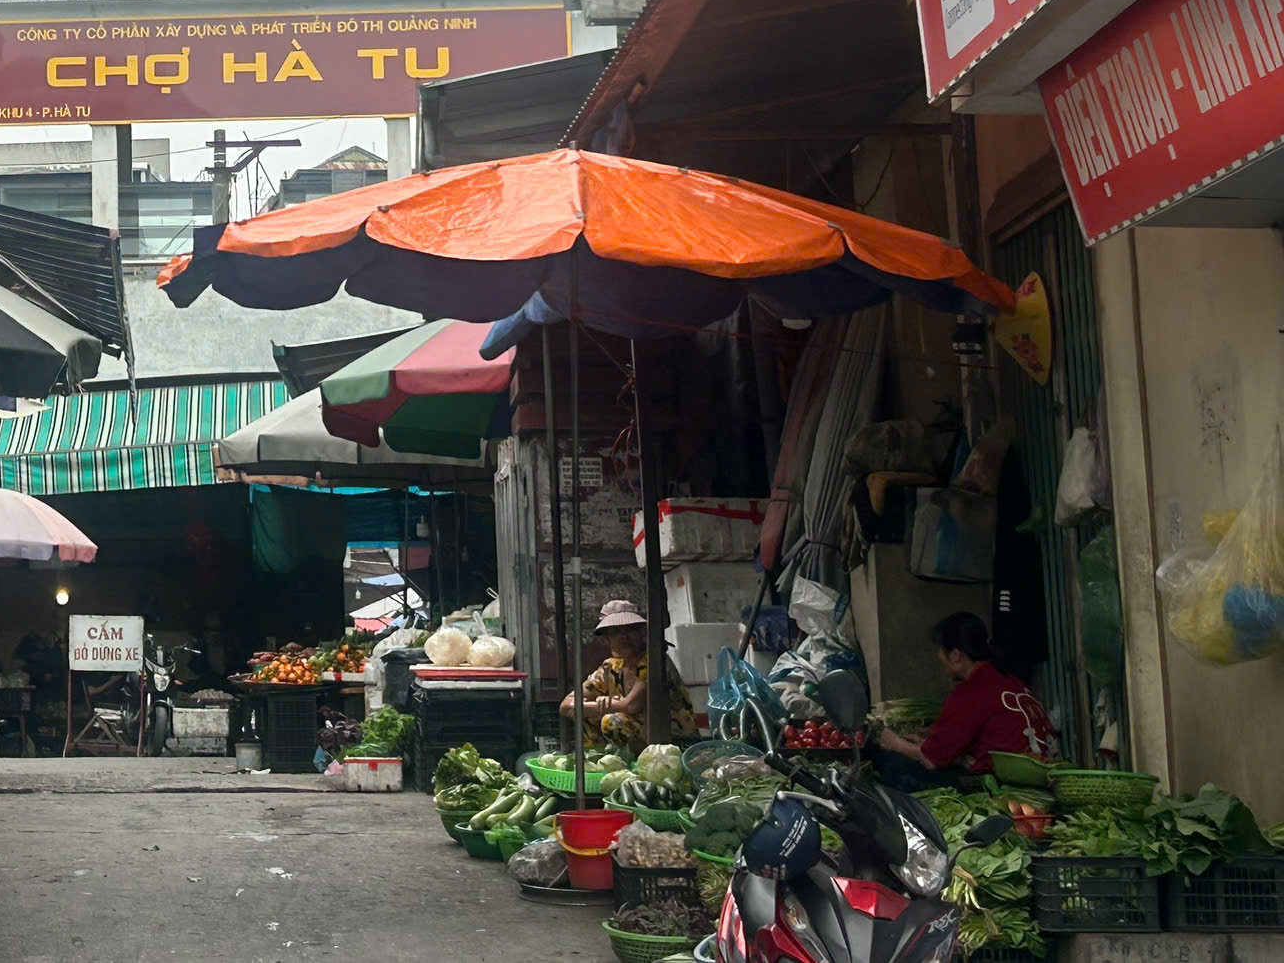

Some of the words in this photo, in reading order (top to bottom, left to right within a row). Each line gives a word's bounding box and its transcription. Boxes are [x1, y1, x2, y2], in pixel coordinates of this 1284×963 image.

[17, 26, 57, 41] CÔNG
[63, 28, 81, 40] TY
[86, 21, 107, 39] CỔ
[112, 22, 149, 39] PHẦN
[156, 23, 181, 37] XÂY
[187, 23, 226, 39] DỰNG
[231, 21, 247, 35] VÀ
[252, 21, 286, 34] PHÁT
[291, 16, 332, 34] TRIỂN
[337, 18, 358, 33] ĐÔ
[361, 20, 383, 34] THỊ
[388, 15, 439, 31] QUẢNG
[444, 18, 476, 29] NINH
[46, 46, 190, 93] CHỢ
[223, 38, 323, 83] HÀ
[357, 46, 450, 79] TU
[1096, 32, 1179, 160] THOẠI
[75, 106, 90, 117] TU
[125, 647, 139, 661] XE
